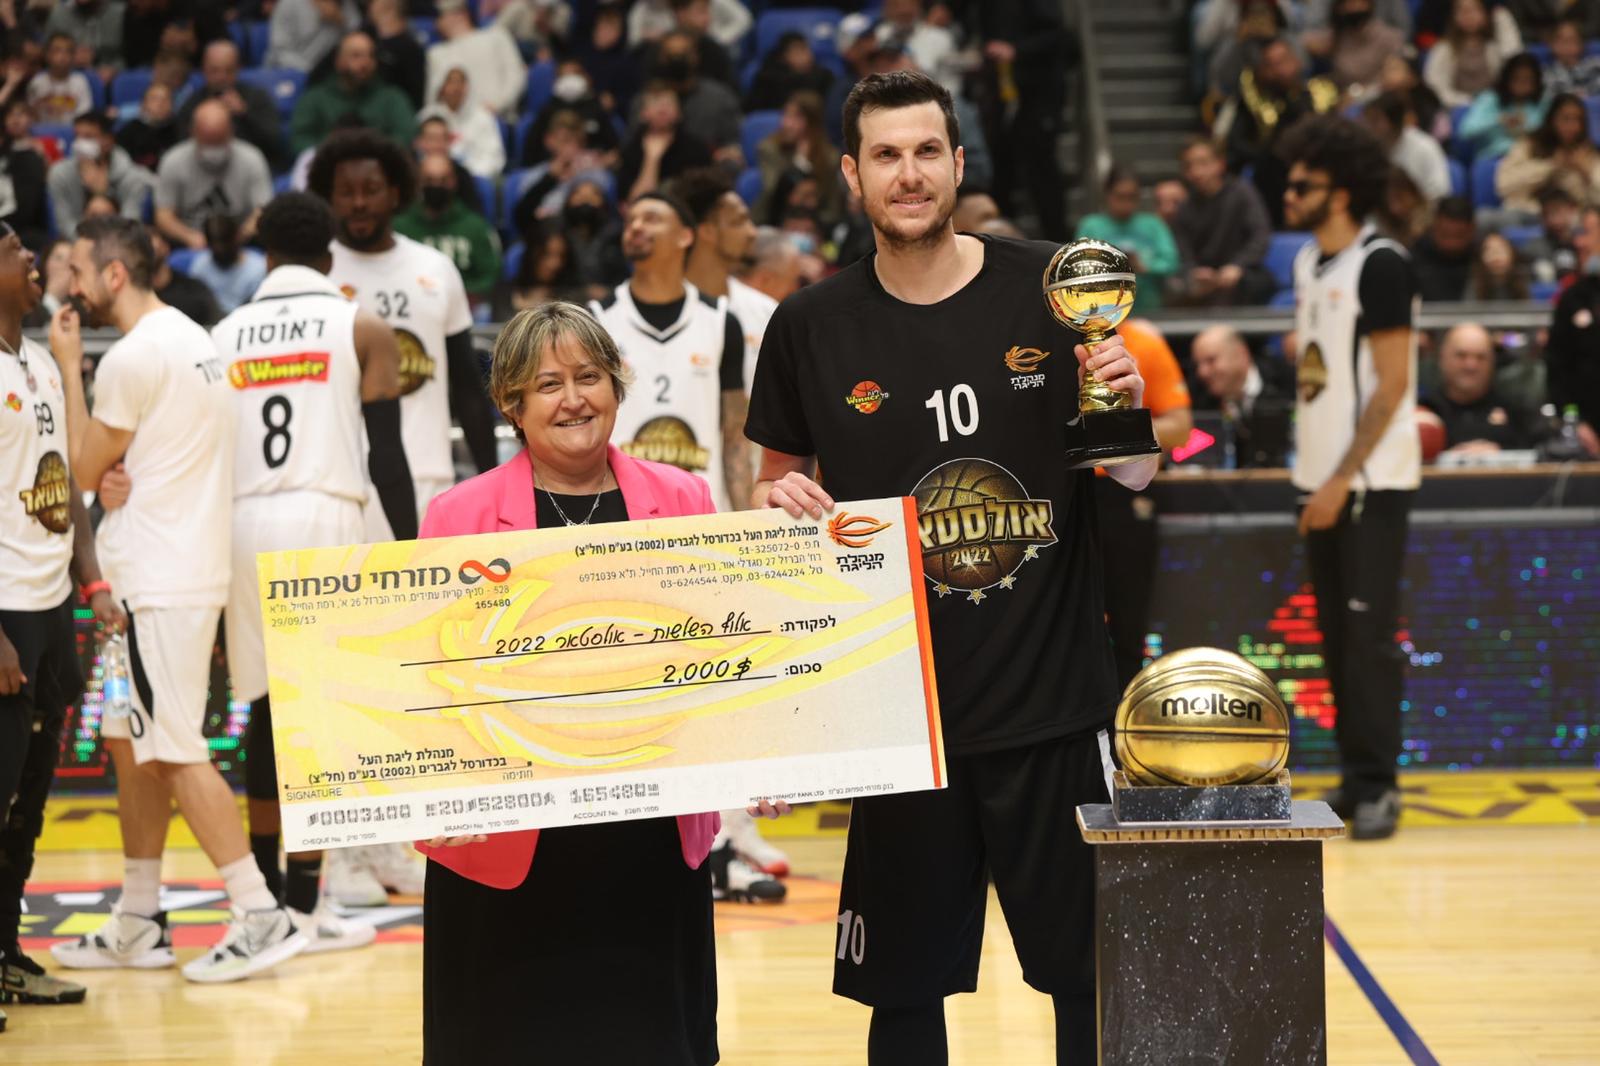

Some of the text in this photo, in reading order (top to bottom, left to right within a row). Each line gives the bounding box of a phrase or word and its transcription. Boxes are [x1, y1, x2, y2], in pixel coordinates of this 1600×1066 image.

[376, 291, 410, 319] 32
[248, 360, 325, 382] Winner
[1010, 373, 1046, 385] מנהלת
[1013, 380, 1044, 391] הליגה
[655, 375, 671, 404] 2
[925, 383, 980, 442] 10
[262, 395, 293, 468] 8
[917, 498, 1054, 550] אולסטא
[575, 525, 819, 557] מנהלת ליגת העל בכדורסל לגברים (2002) בע"מ (חל"צ)
[739, 542, 800, 555] 51-325072-0
[766, 557, 776, 566] 27
[778, 554, 806, 565] הברזל
[836, 553, 885, 565] מנהלת
[951, 545, 992, 567] 2022
[737, 557, 763, 569] מגדלי
[840, 561, 883, 573] הליגה
[666, 565, 685, 575] רמת
[267, 567, 451, 600] מזרחי טפחות
[579, 572, 617, 583] 6971039
[660, 575, 718, 589] 03-6244544
[443, 589, 463, 600] קרית
[465, 587, 484, 599] סניף
[494, 585, 510, 595] 528
[317, 600, 336, 610] רמת
[351, 598, 361, 607] 26
[363, 595, 390, 606] הברזל
[475, 599, 512, 610] 165480
[271, 615, 317, 628] 29/09/13
[721, 611, 752, 634] אלוף
[780, 614, 837, 633] לפקודת:
[555, 623, 625, 649] אולסטאר
[650, 616, 714, 643] השלשות
[495, 635, 546, 655] 2022
[784, 662, 822, 675] סכום:
[1161, 693, 1262, 722] molten
[358, 747, 454, 765] מנהלת ליגת העל
[308, 756, 507, 785] בכדורסל לגברים (2002) בע"מ (חל"צ)
[502, 769, 533, 781] חתימה
[286, 787, 343, 801] SIGNATURE
[573, 810, 606, 820] ACCOUNT
[837, 909, 865, 965] 10
